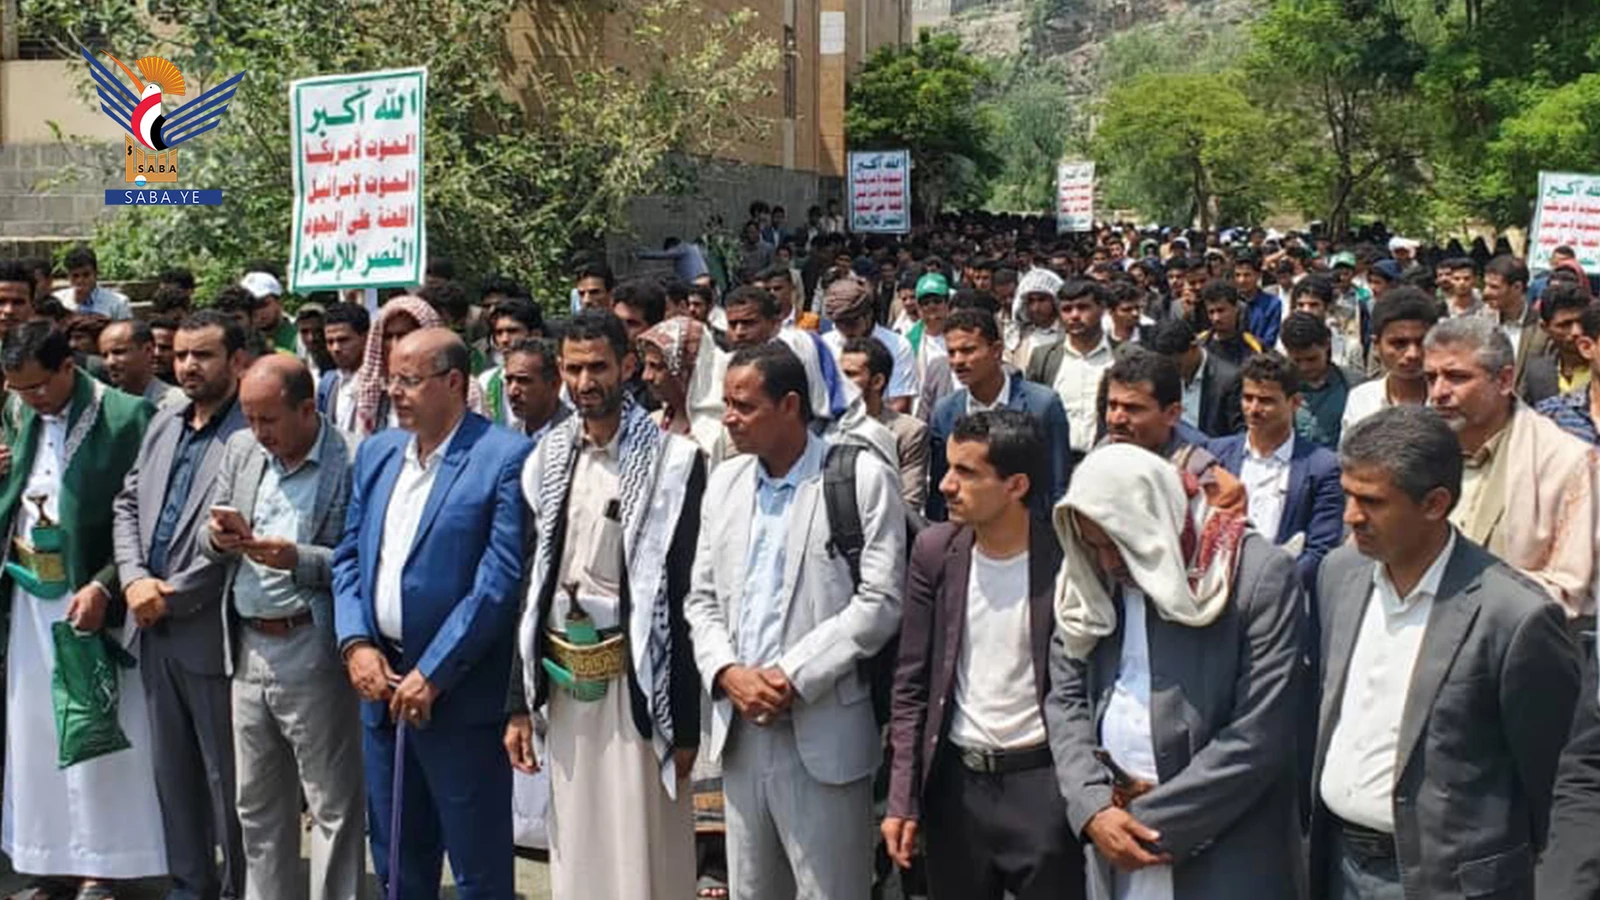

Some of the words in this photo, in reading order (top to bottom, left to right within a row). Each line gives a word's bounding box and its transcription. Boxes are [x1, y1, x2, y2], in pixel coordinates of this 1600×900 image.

[306, 84, 372, 137] أكبر
[374, 87, 417, 119] الله
[365, 134, 416, 161] الموت
[364, 170, 415, 198] الموت
[304, 211, 343, 238] اليهود
[377, 203, 414, 228] اللعنة
[361, 237, 413, 277] النصر
